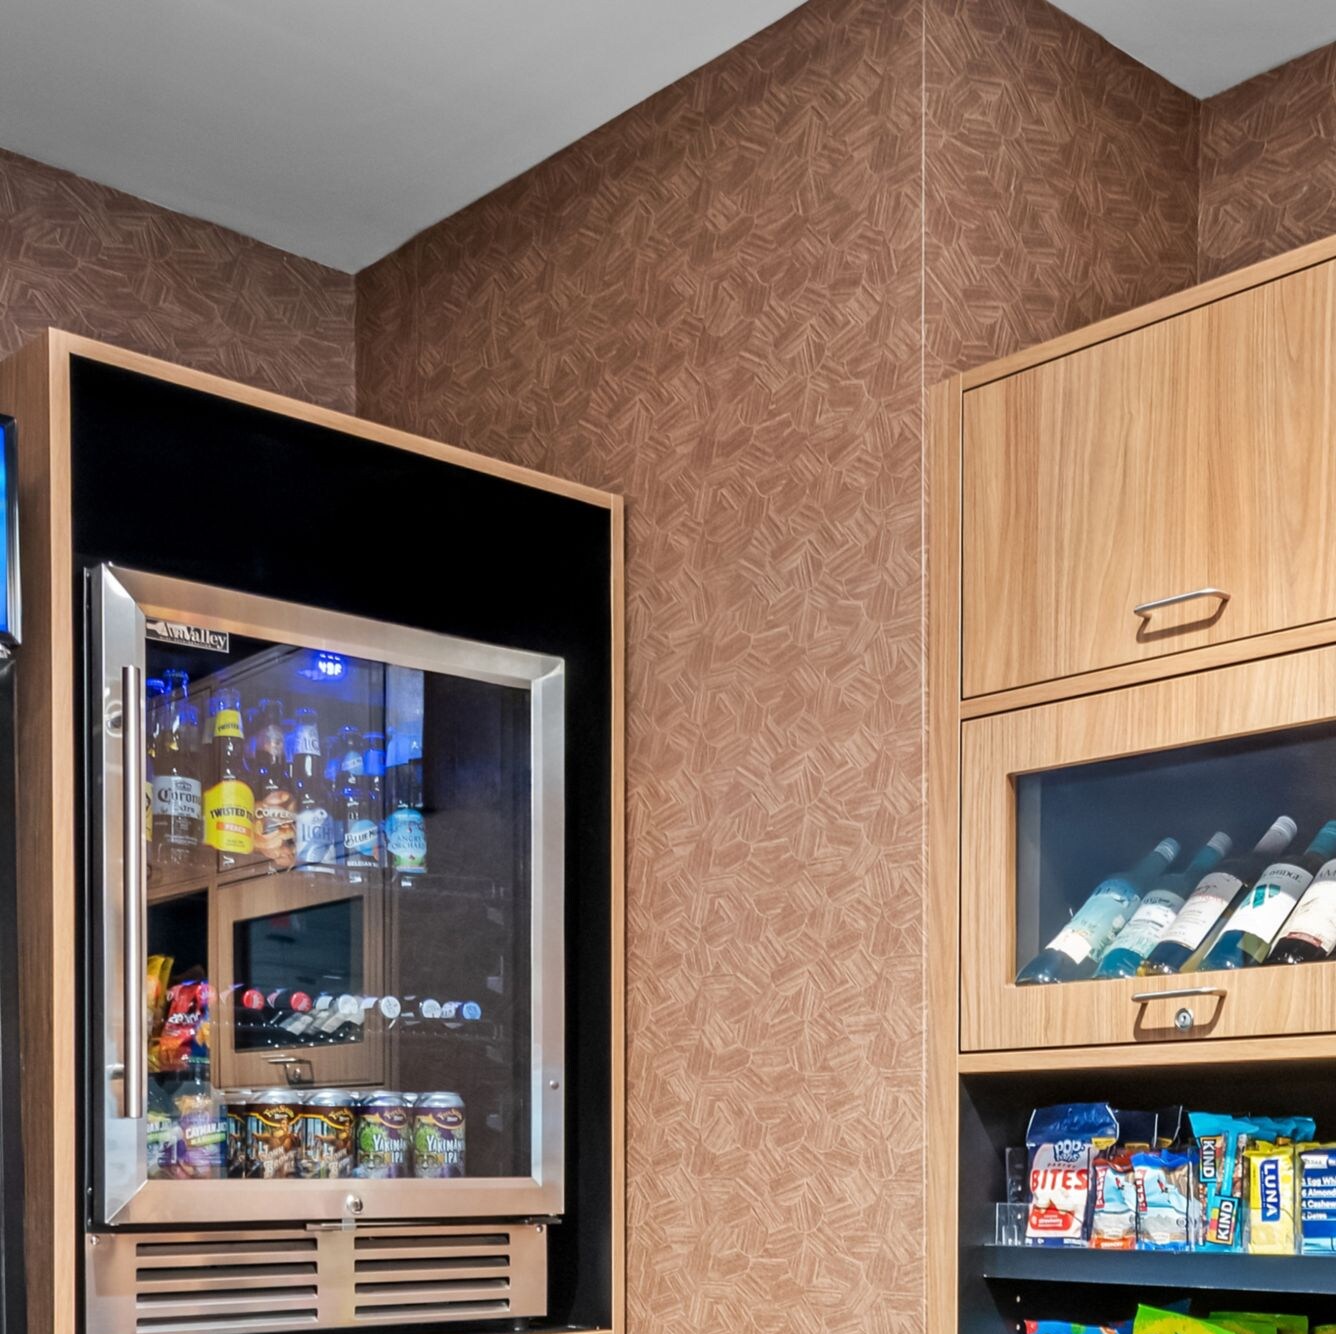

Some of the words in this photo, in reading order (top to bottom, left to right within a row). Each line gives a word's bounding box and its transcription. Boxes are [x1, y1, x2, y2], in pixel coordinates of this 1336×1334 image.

[444, 1151, 459, 1164] IPA
[1203, 1140, 1215, 1178] KIND
[1031, 1168, 1090, 1192] BITES
[1264, 1164, 1278, 1217] LUNA
[1307, 1178, 1320, 1187] Egg
[1217, 1201, 1233, 1240] KIND
[1307, 1212, 1328, 1220] Dates
